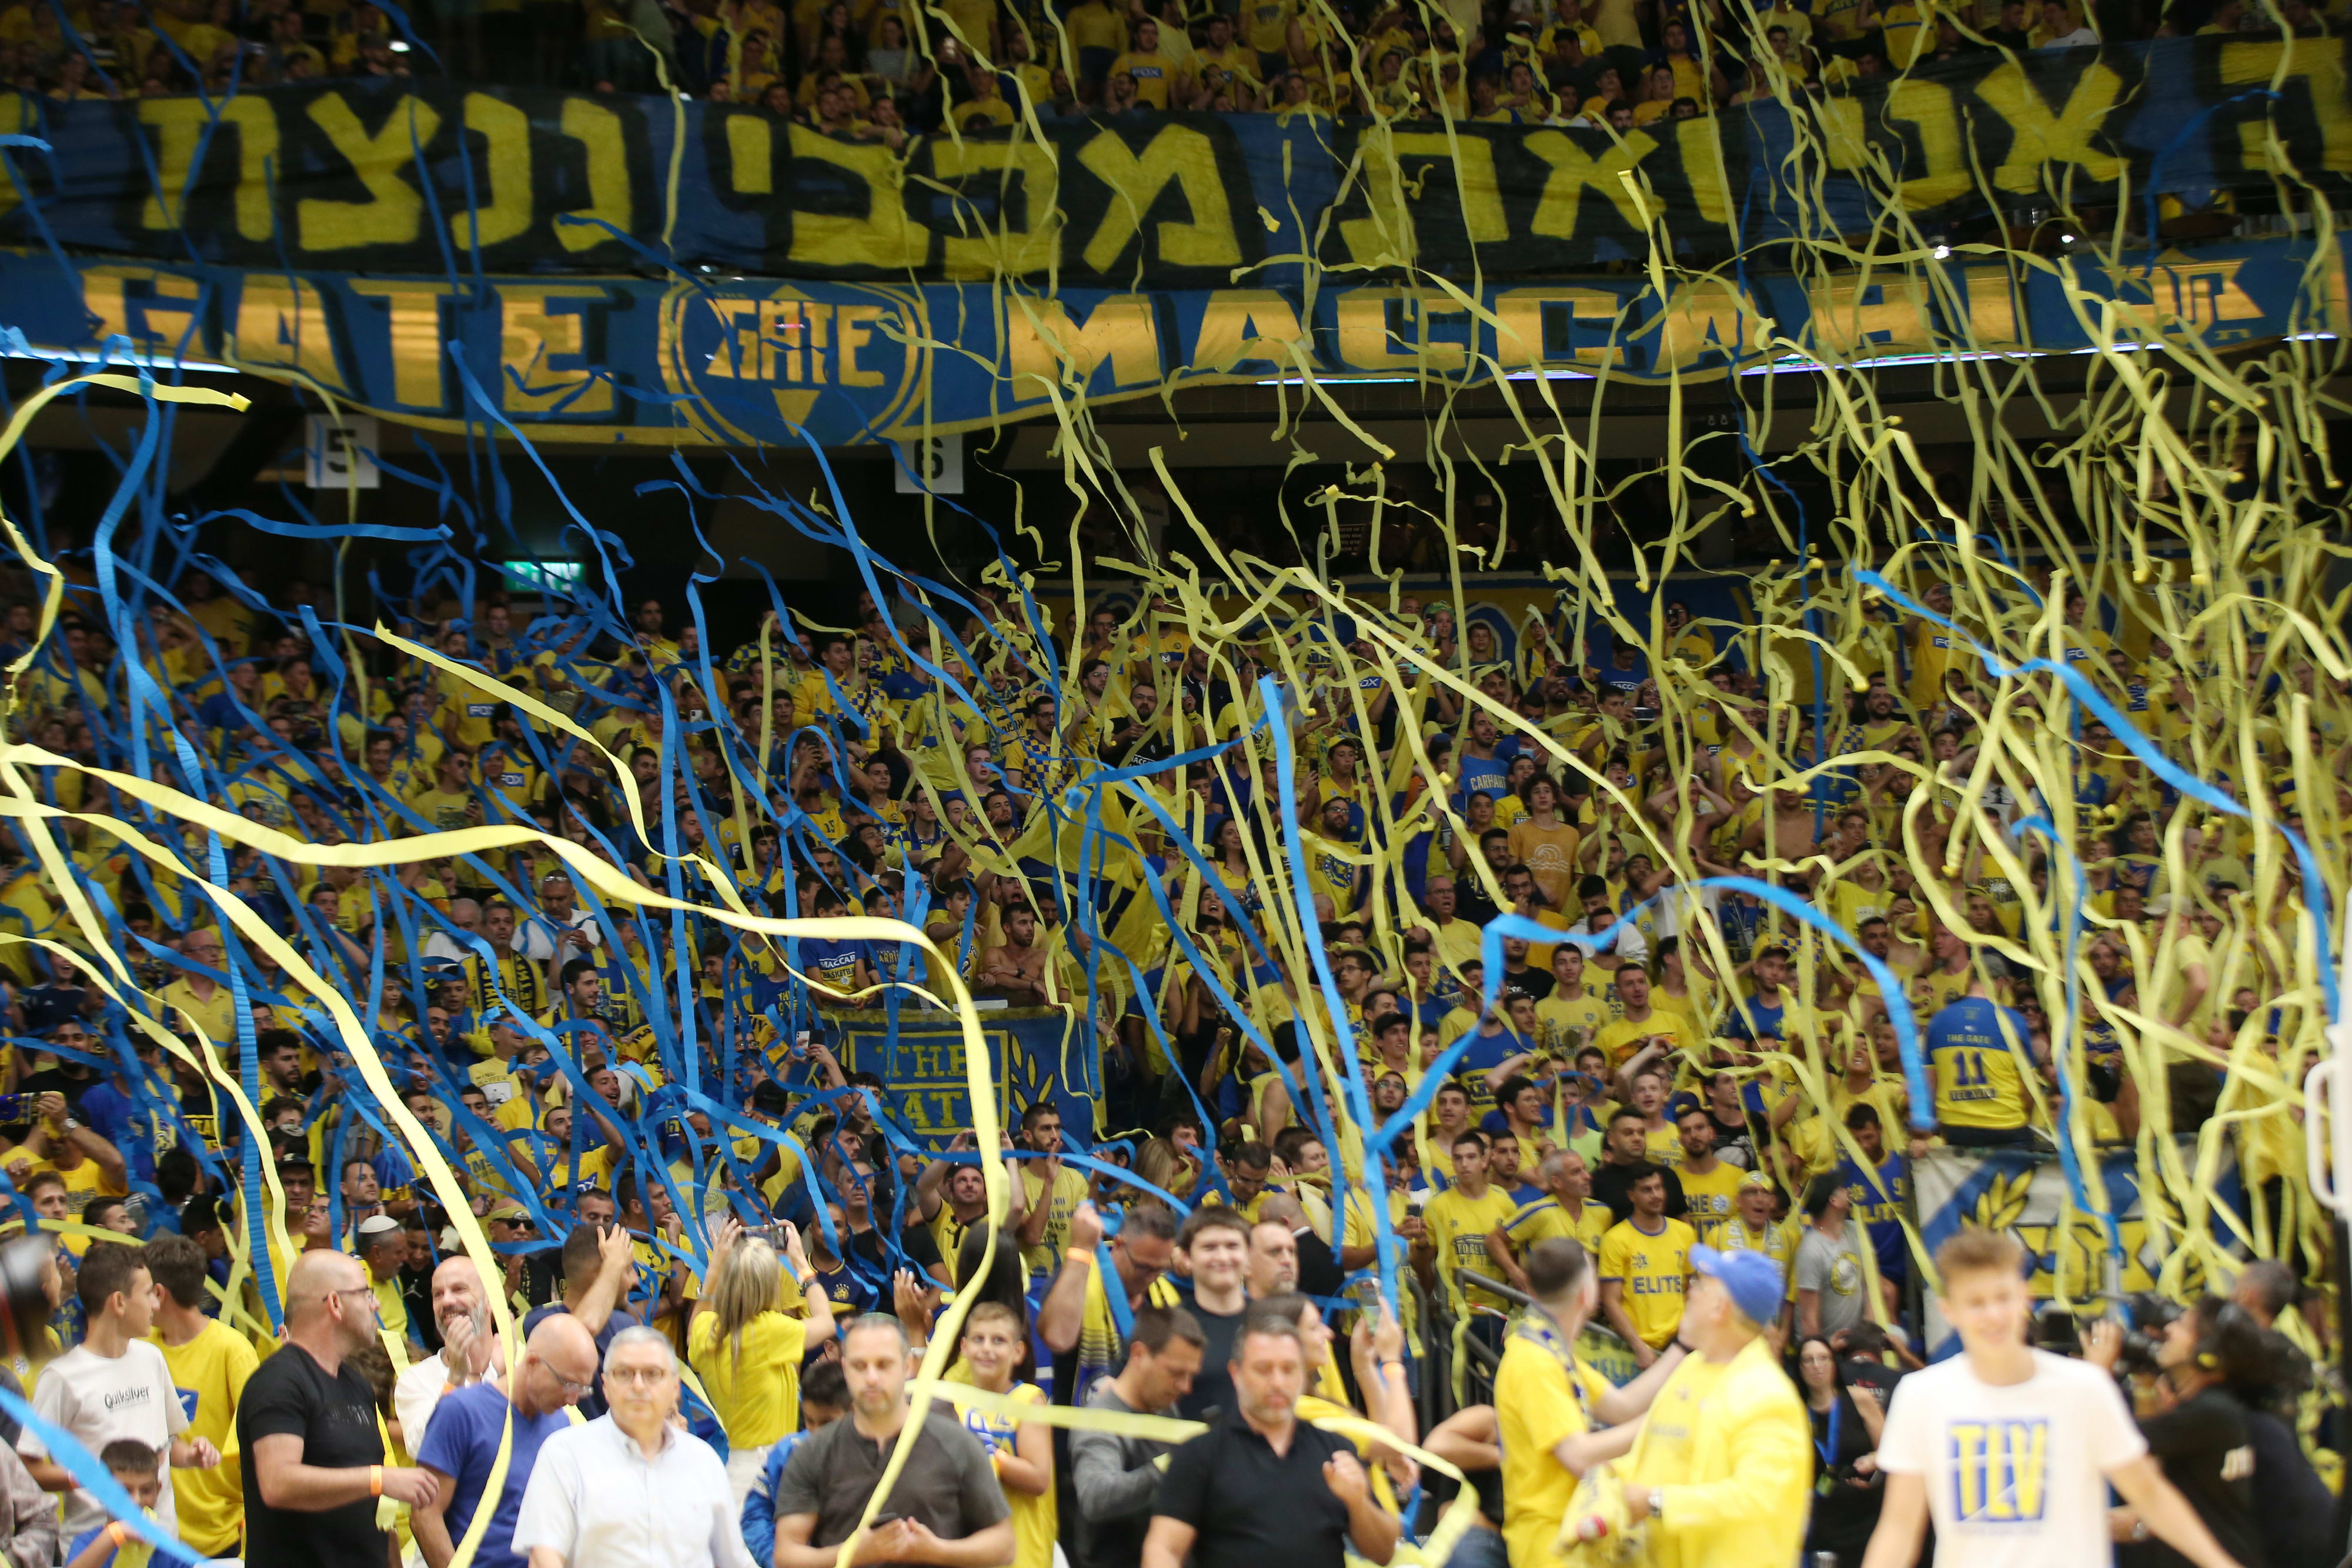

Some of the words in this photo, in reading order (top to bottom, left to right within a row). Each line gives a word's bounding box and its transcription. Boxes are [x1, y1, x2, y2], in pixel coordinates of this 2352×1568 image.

[1822, 62, 2130, 215] אני
[140, 91, 632, 252] ננצח
[726, 115, 1242, 280] מכבי
[1339, 118, 1732, 268] ואת
[80, 265, 615, 413] GATE
[706, 299, 885, 388] GATE
[1003, 265, 2018, 402] MACCABI
[325, 429, 358, 470] 5
[913, 436, 944, 480] 6
[1359, 678, 1379, 688] OX
[820, 953, 856, 969] MACCAB
[823, 967, 856, 979] BASKETBA
[1947, 1034, 1963, 1042] THE
[876, 1043, 967, 1078] THE
[1953, 1051, 1987, 1085] 11
[1633, 1275, 1683, 1295] ELITE
[103, 1384, 151, 1410] Quiksilver
[1950, 1423, 2049, 1522] TLV
